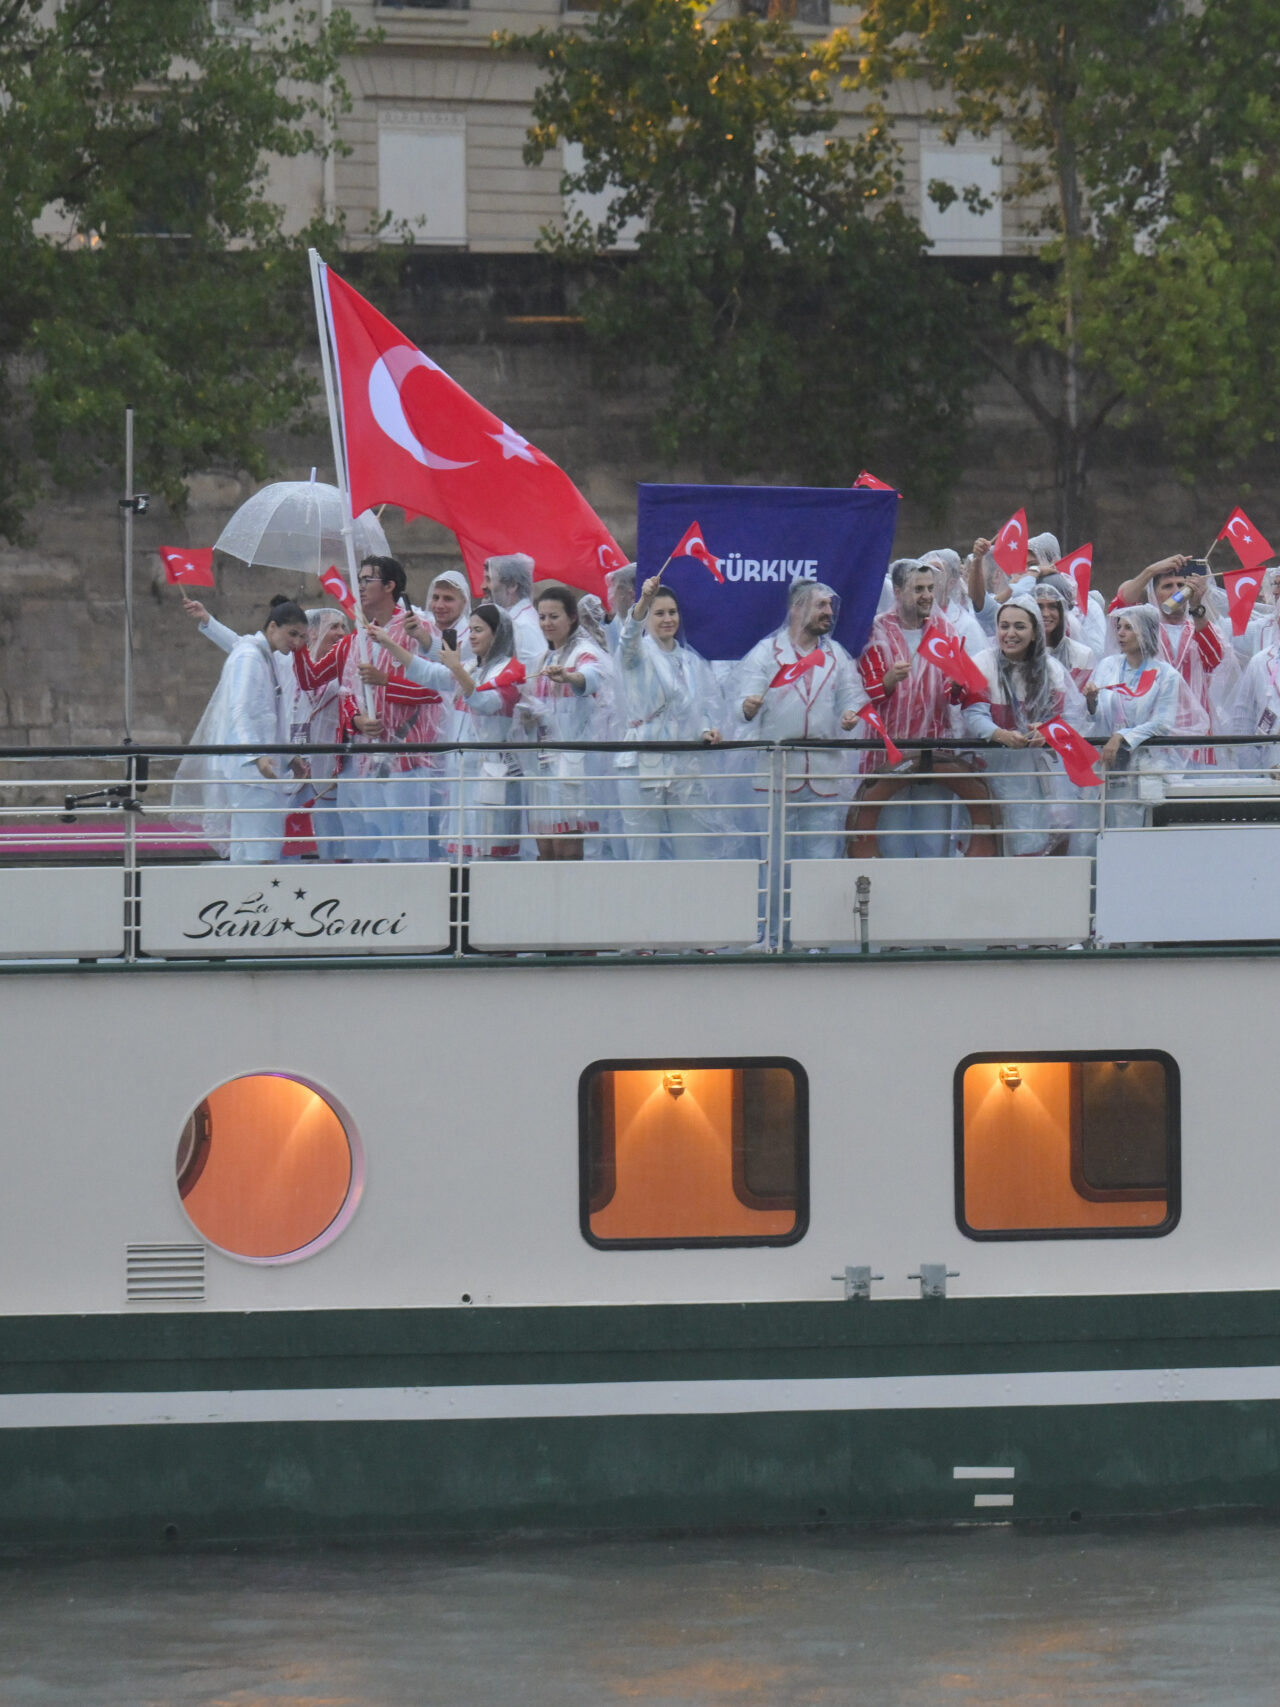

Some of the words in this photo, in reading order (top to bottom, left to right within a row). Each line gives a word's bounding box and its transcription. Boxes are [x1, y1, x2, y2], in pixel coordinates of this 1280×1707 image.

[183, 901, 280, 939] Sans
[295, 899, 407, 937] Souci
[234, 892, 271, 915] La
